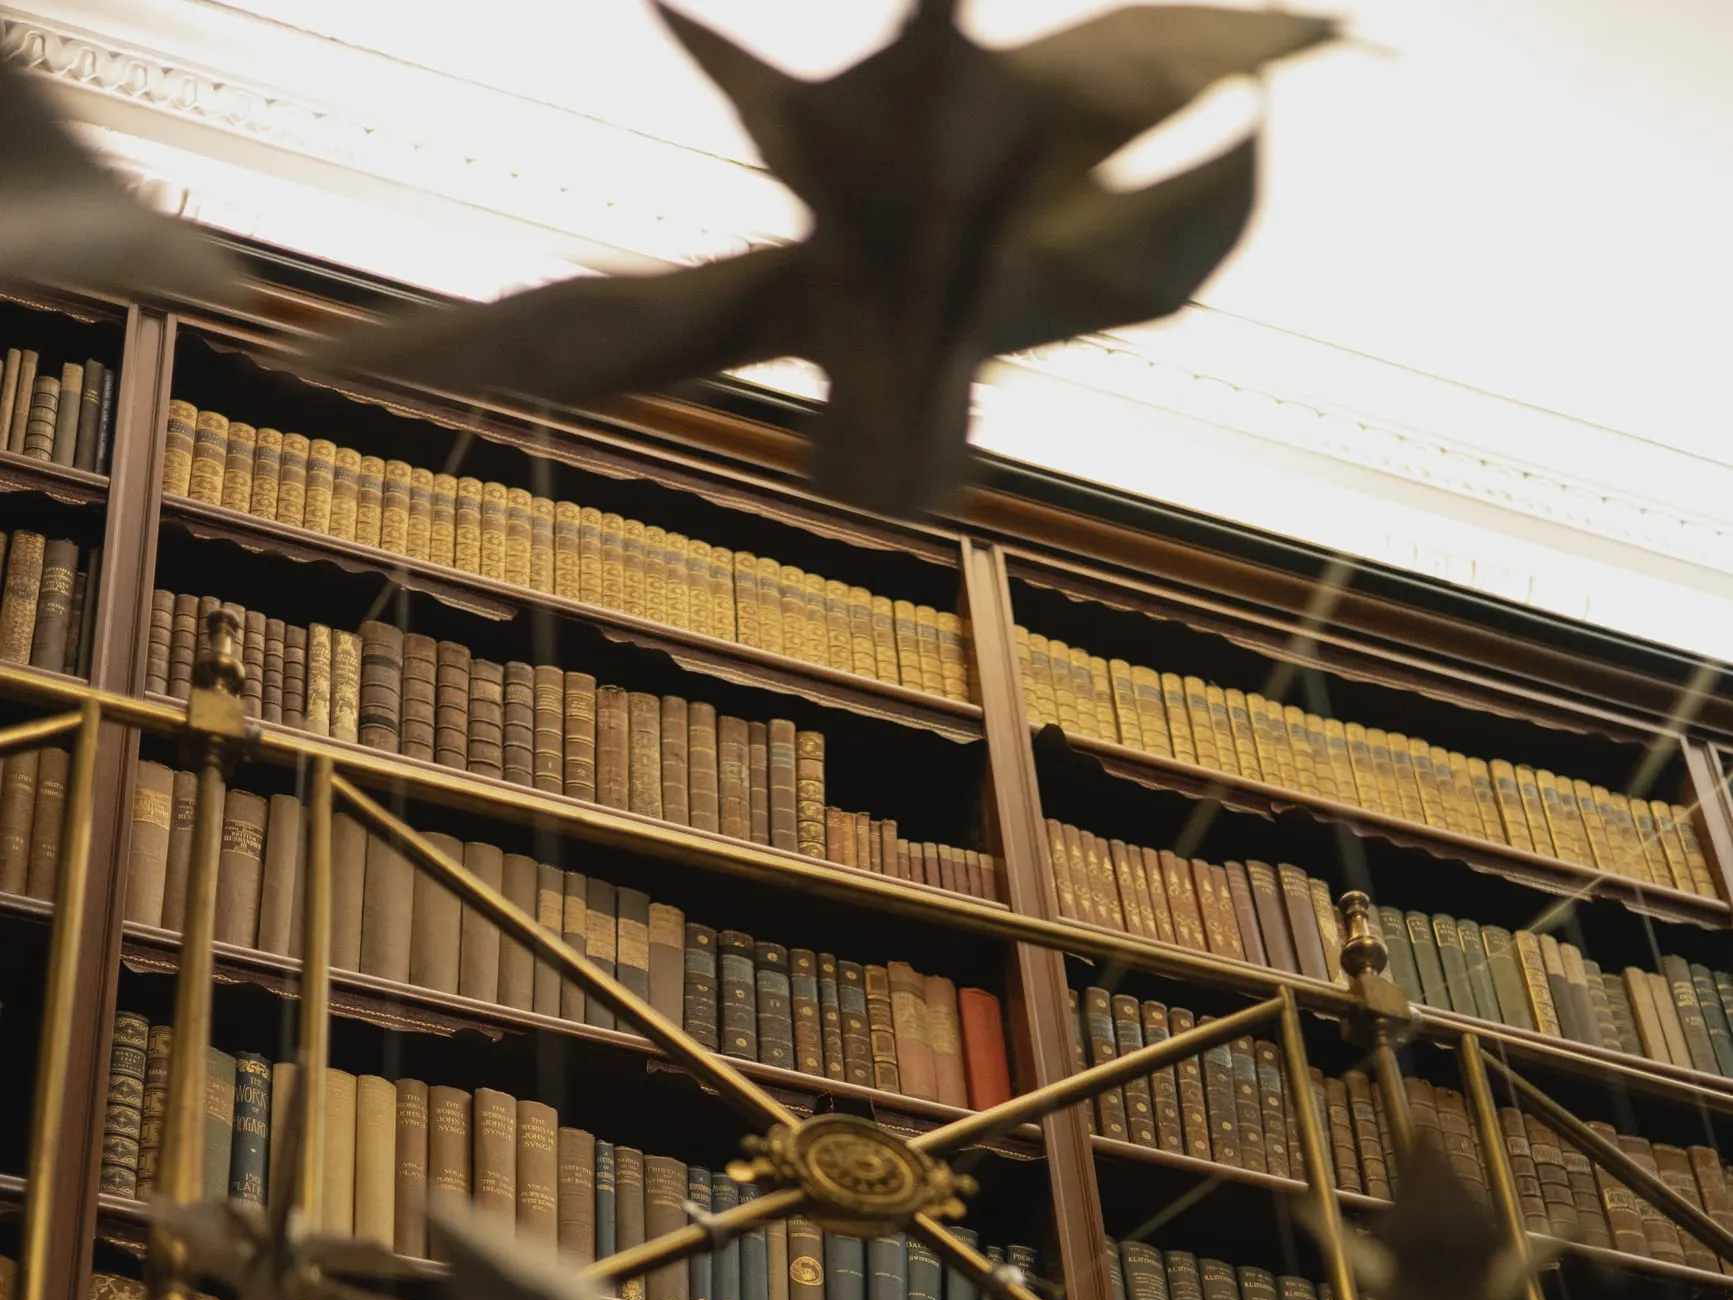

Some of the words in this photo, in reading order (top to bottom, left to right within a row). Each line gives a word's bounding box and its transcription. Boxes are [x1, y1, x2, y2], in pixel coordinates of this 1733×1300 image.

[249, 1077, 262, 1087] THE
[234, 1086, 267, 1110] WORK
[233, 1116, 267, 1138] HOGAR
